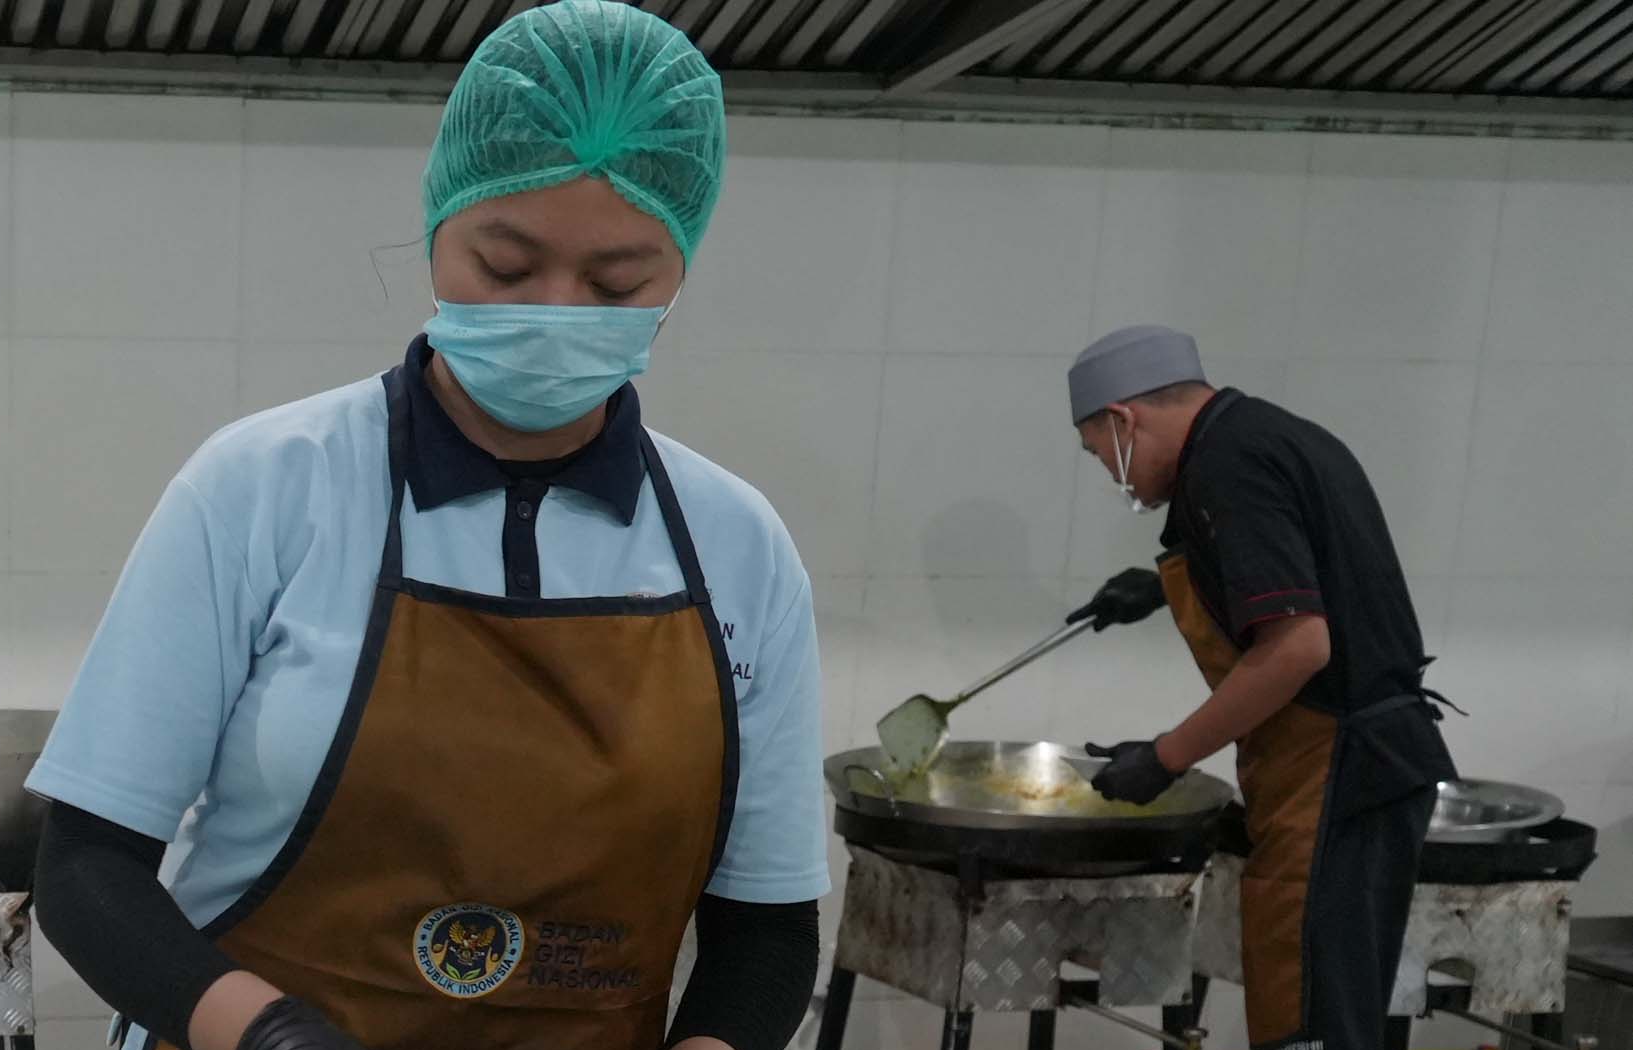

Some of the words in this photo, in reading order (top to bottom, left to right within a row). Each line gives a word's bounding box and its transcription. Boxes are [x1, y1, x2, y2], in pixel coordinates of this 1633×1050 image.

[540, 920, 625, 943] BADAN
[535, 943, 585, 967] GIZI
[418, 945, 454, 992] REPUBLIK
[458, 959, 514, 994] INDONESIA
[528, 966, 640, 989] NASIONAL
